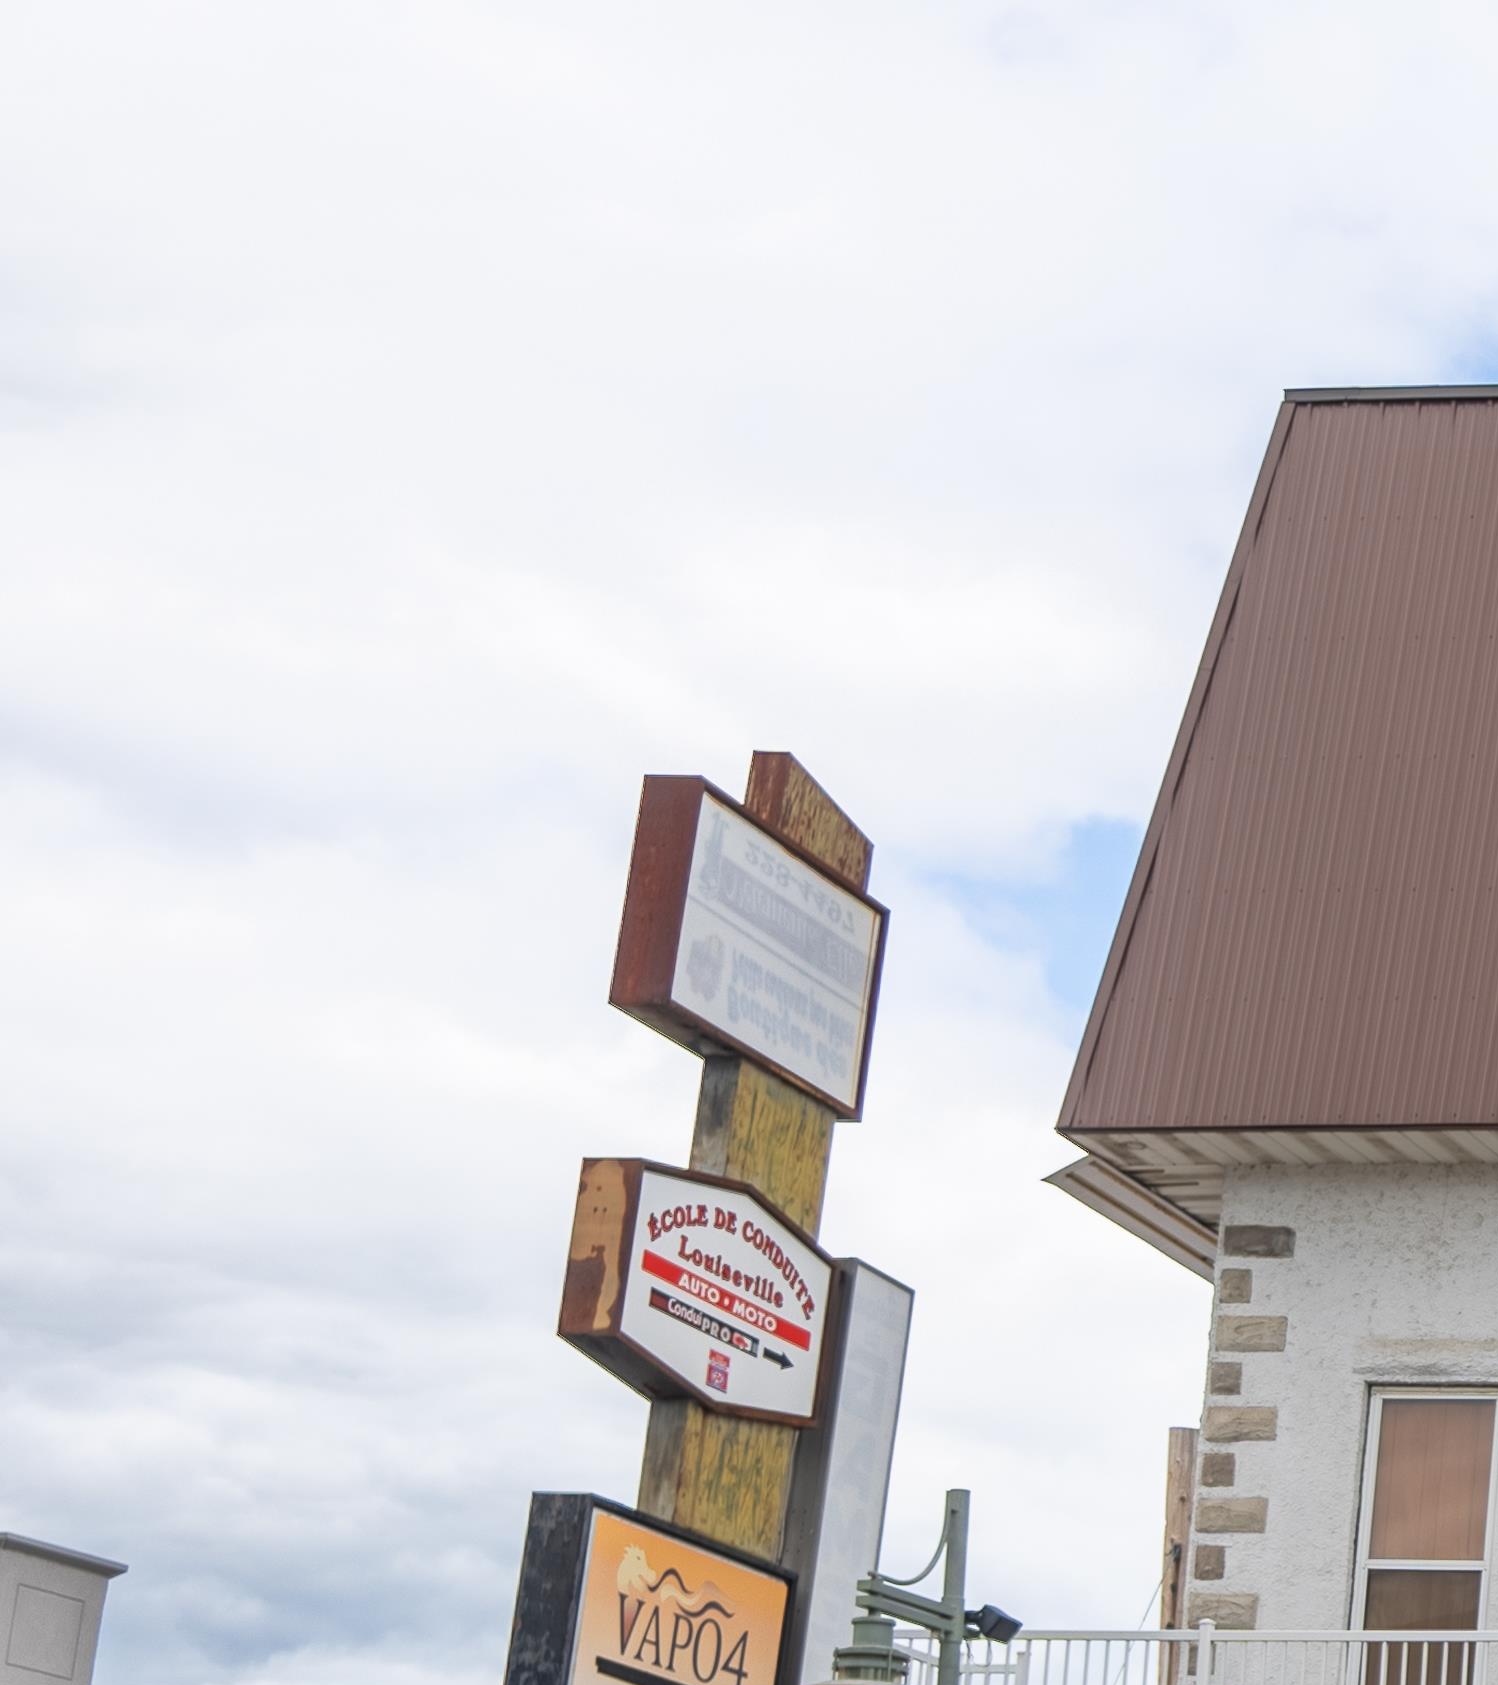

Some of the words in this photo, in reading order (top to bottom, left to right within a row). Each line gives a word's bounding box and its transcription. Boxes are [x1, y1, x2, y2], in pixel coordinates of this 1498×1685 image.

[647, 1204, 709, 1242] ÉCOLE
[713, 1206, 738, 1235] DE
[742, 1220, 815, 1321] CONDUITE
[677, 1234, 784, 1308] Louiseville
[678, 1273, 720, 1303] AUTO
[732, 1301, 777, 1332] MOTO
